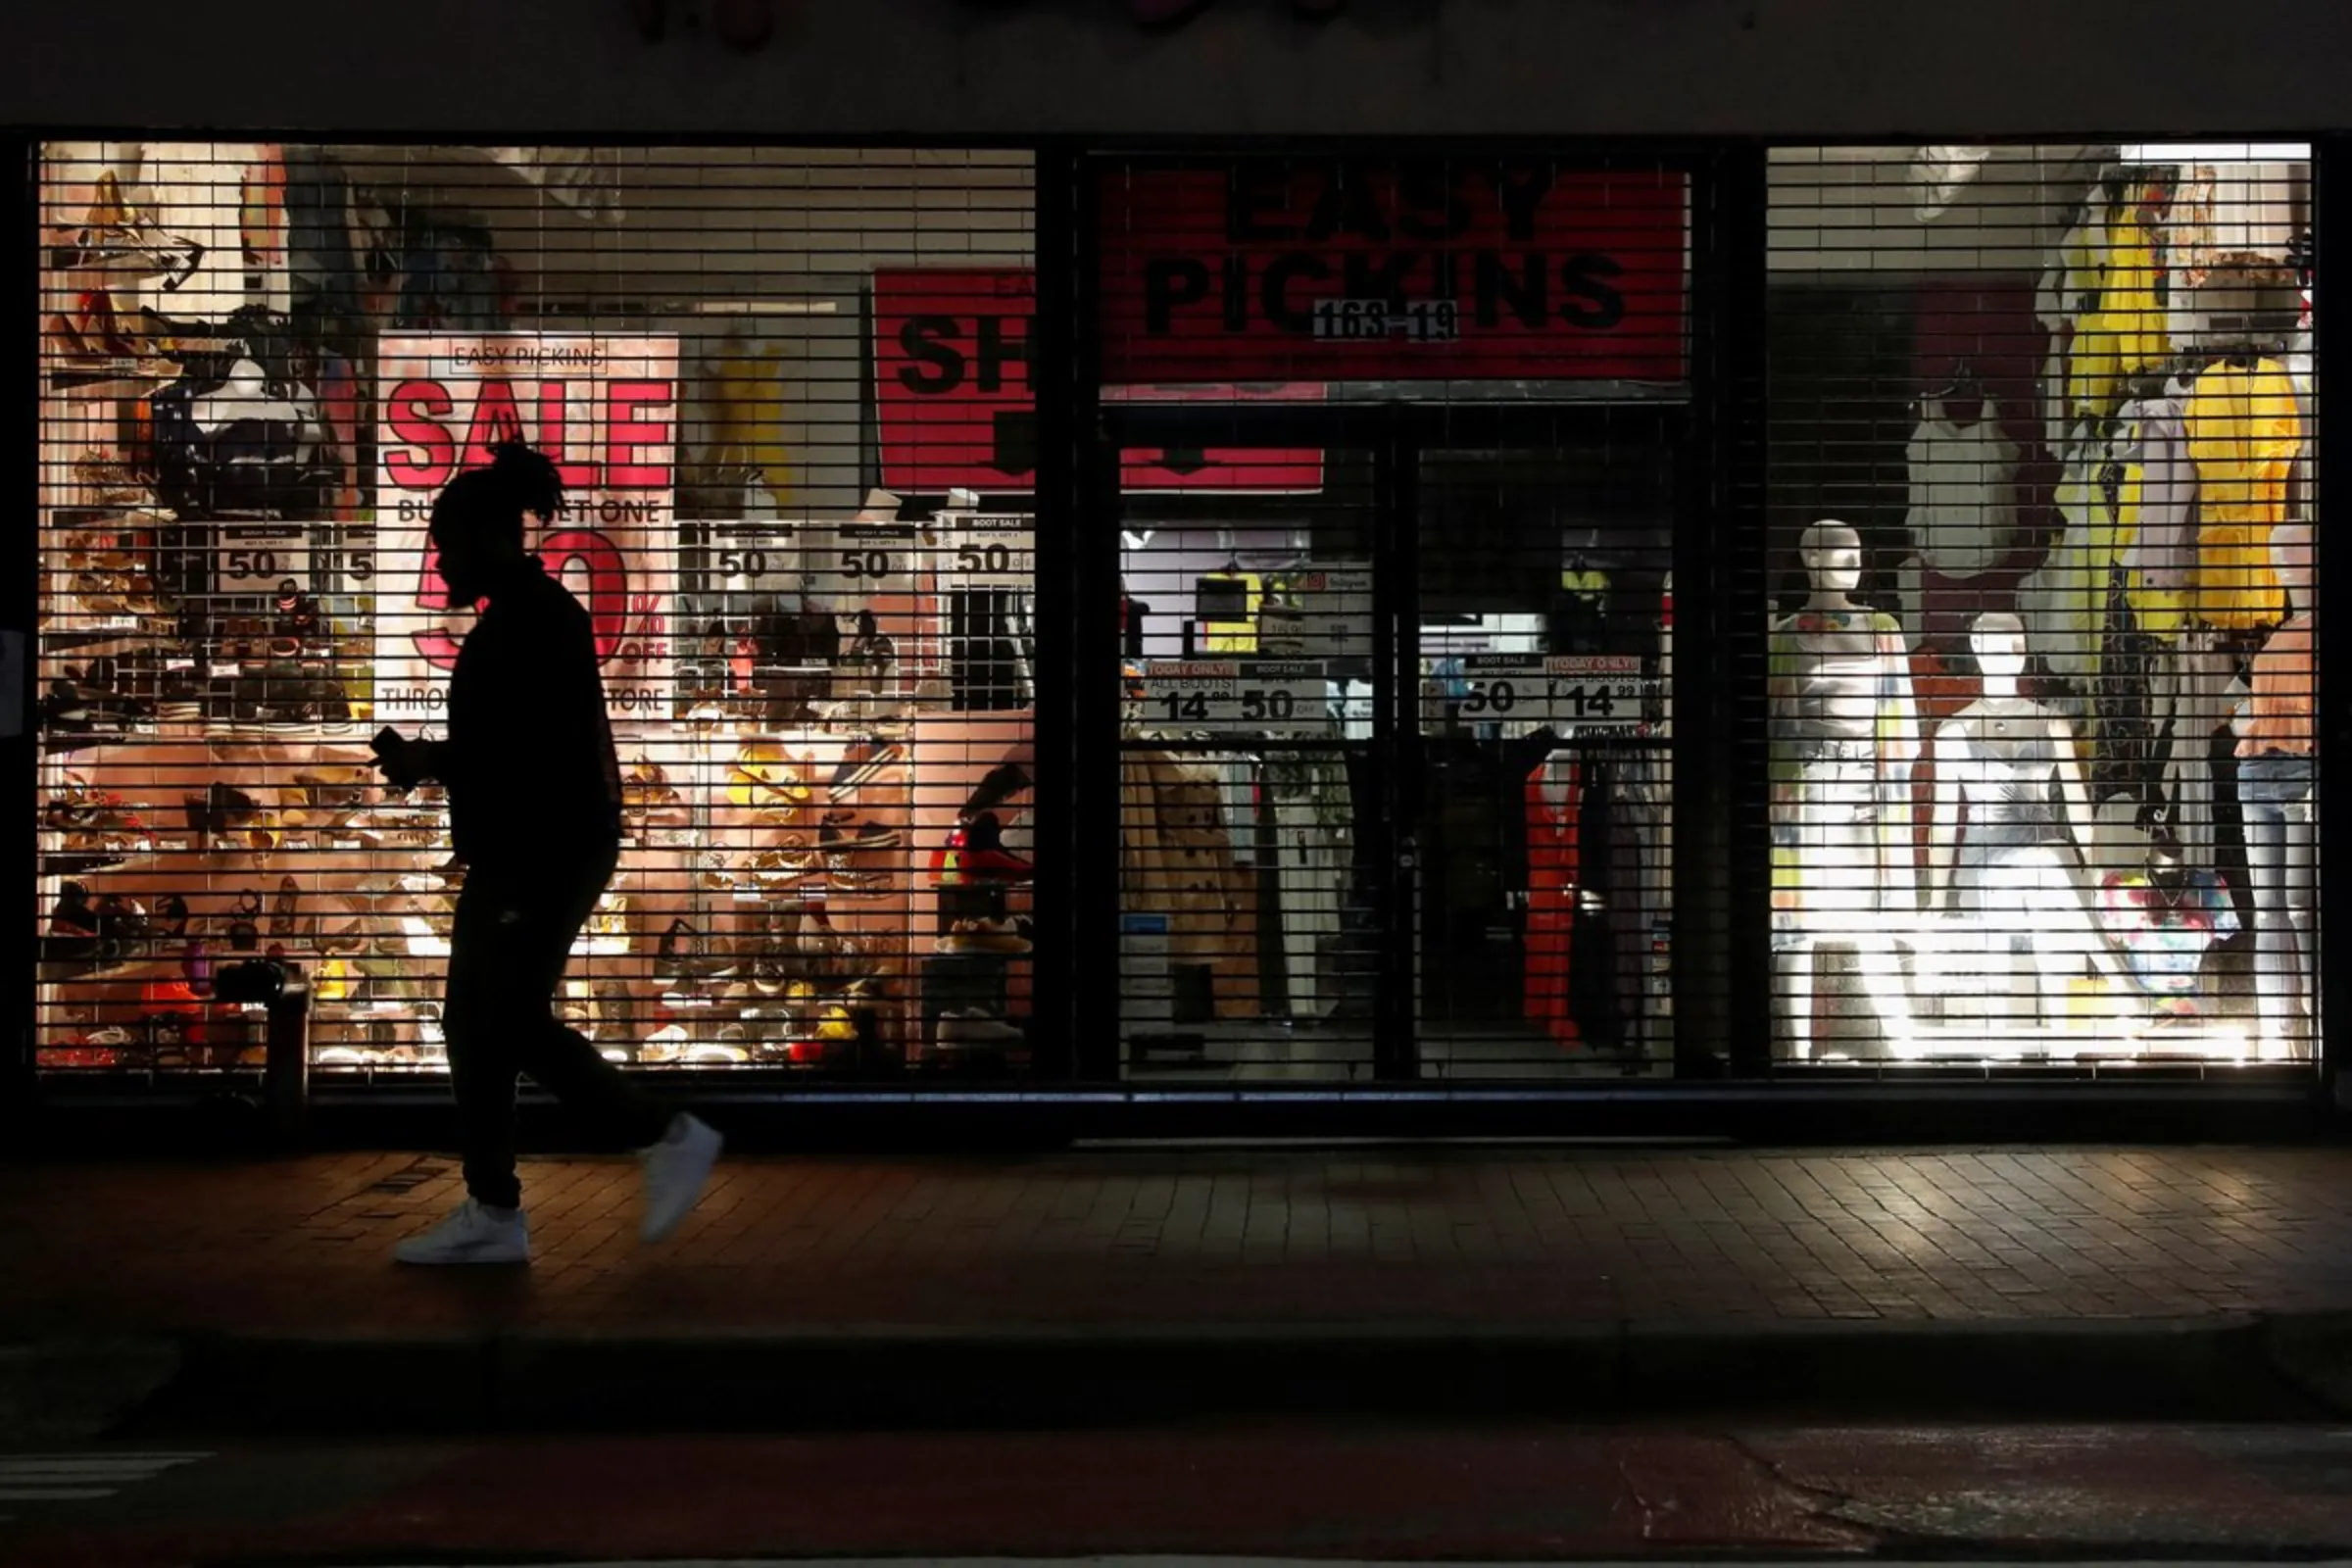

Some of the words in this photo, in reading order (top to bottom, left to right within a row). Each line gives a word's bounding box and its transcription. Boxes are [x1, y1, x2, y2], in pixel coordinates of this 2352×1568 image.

[1224, 163, 1556, 243] EASY
[1144, 253, 1624, 334] PICKINS
[454, 347, 508, 367] EASY
[515, 346, 603, 367] PICKINS
[383, 378, 674, 491] SALE
[398, 498, 432, 523] BU
[600, 499, 662, 523] ONE
[228, 550, 275, 579] 50
[719, 550, 766, 578] 50
[841, 550, 889, 578] 50
[957, 545, 1008, 571] 50
[620, 643, 667, 663] OFF
[601, 689, 664, 710] TORE
[1160, 692, 1208, 722] 14
[1242, 690, 1294, 721] 50
[1464, 682, 1514, 712] 50
[1565, 686, 1614, 716] 14
